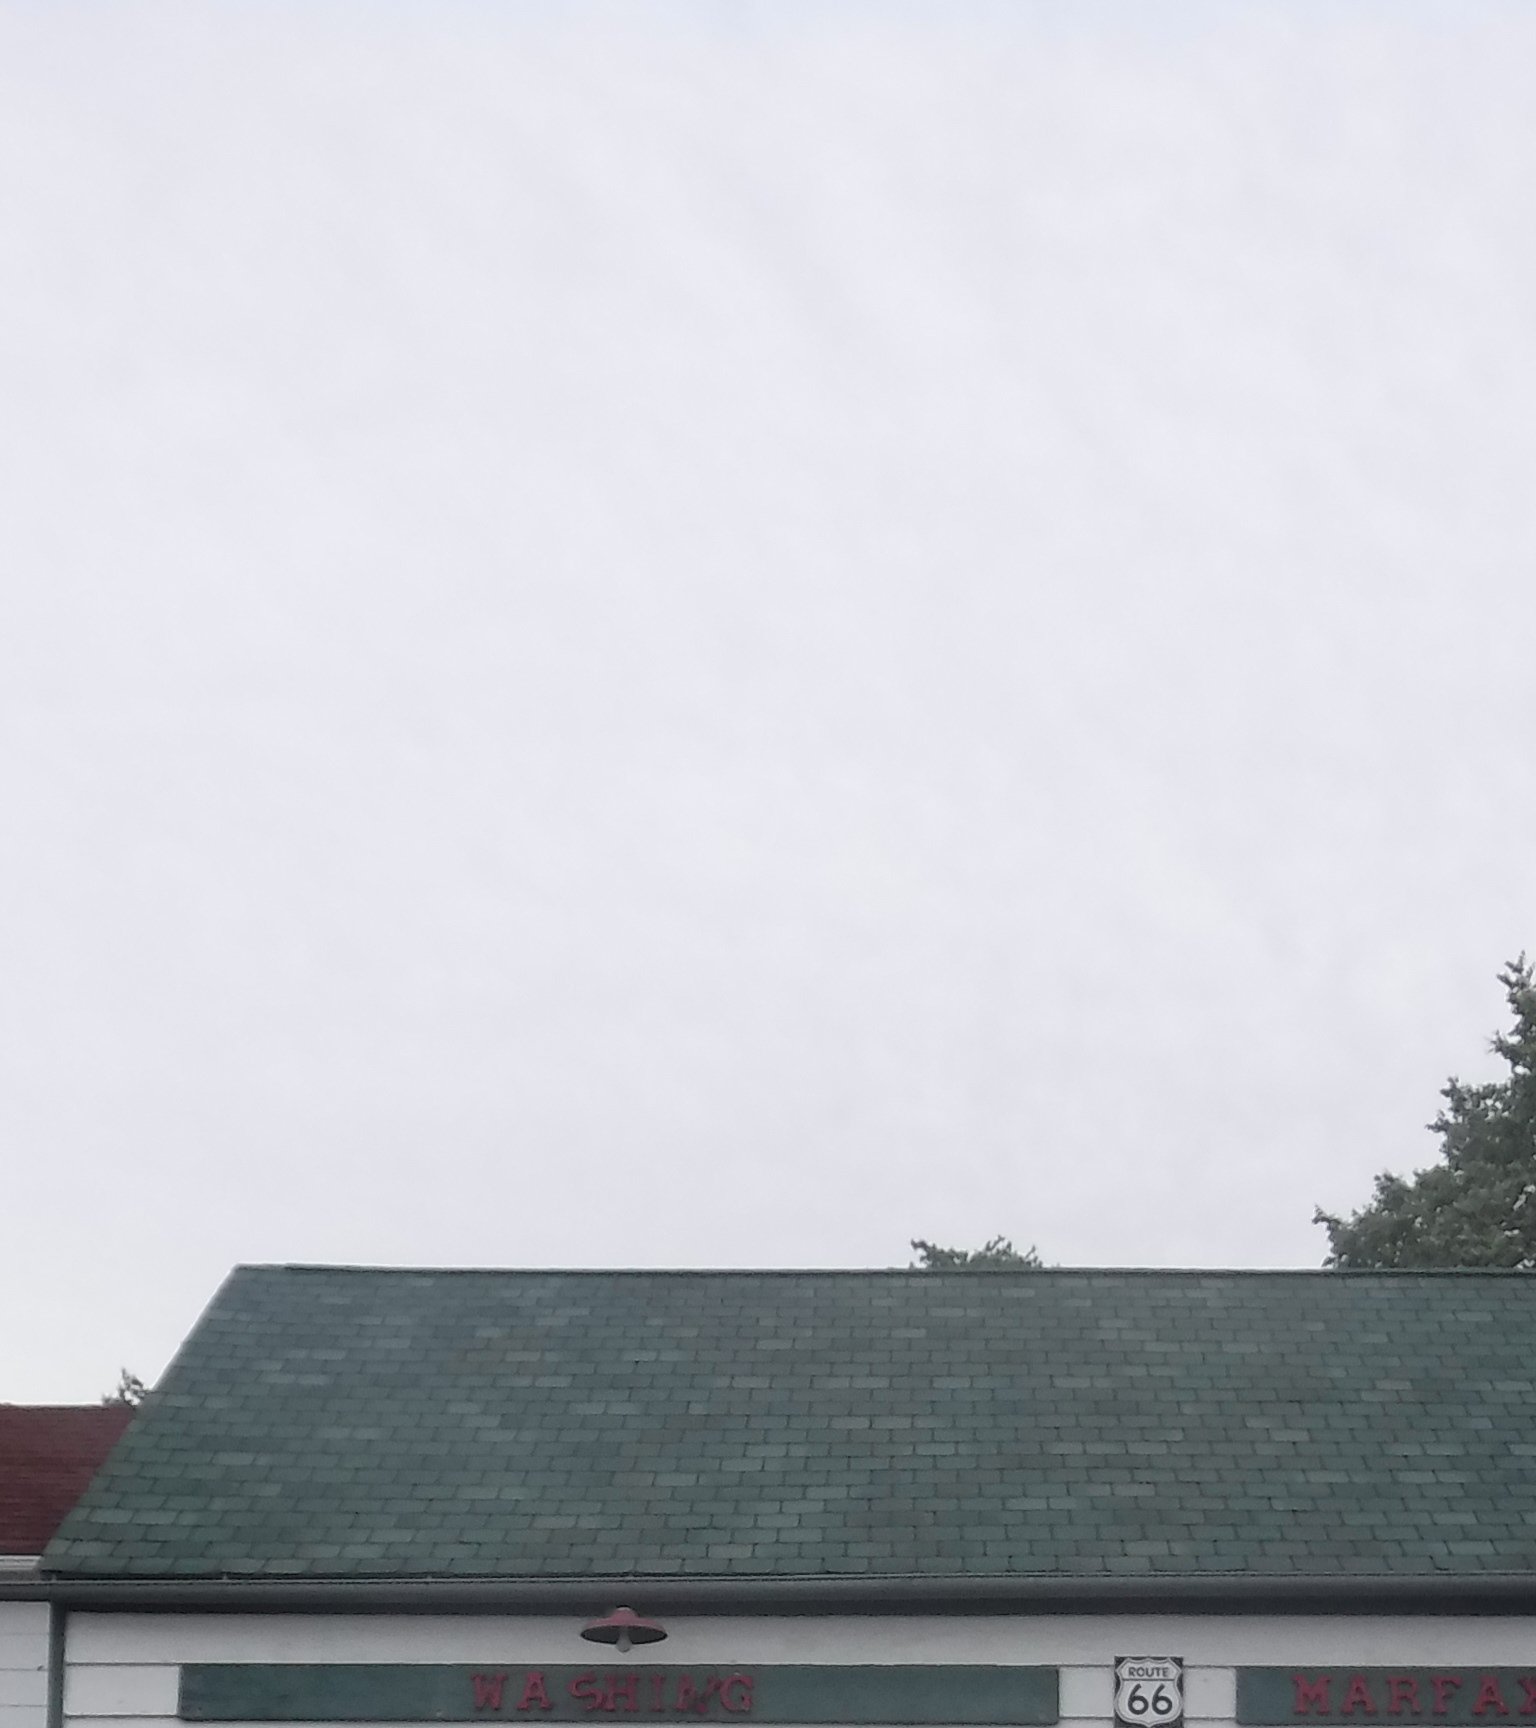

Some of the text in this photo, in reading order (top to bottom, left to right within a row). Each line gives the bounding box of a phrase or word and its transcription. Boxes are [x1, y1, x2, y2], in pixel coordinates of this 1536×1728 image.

[1128, 1666, 1169, 1678] ROUTE
[471, 1671, 755, 1714] WASHING
[1127, 1683, 1173, 1716] 66
